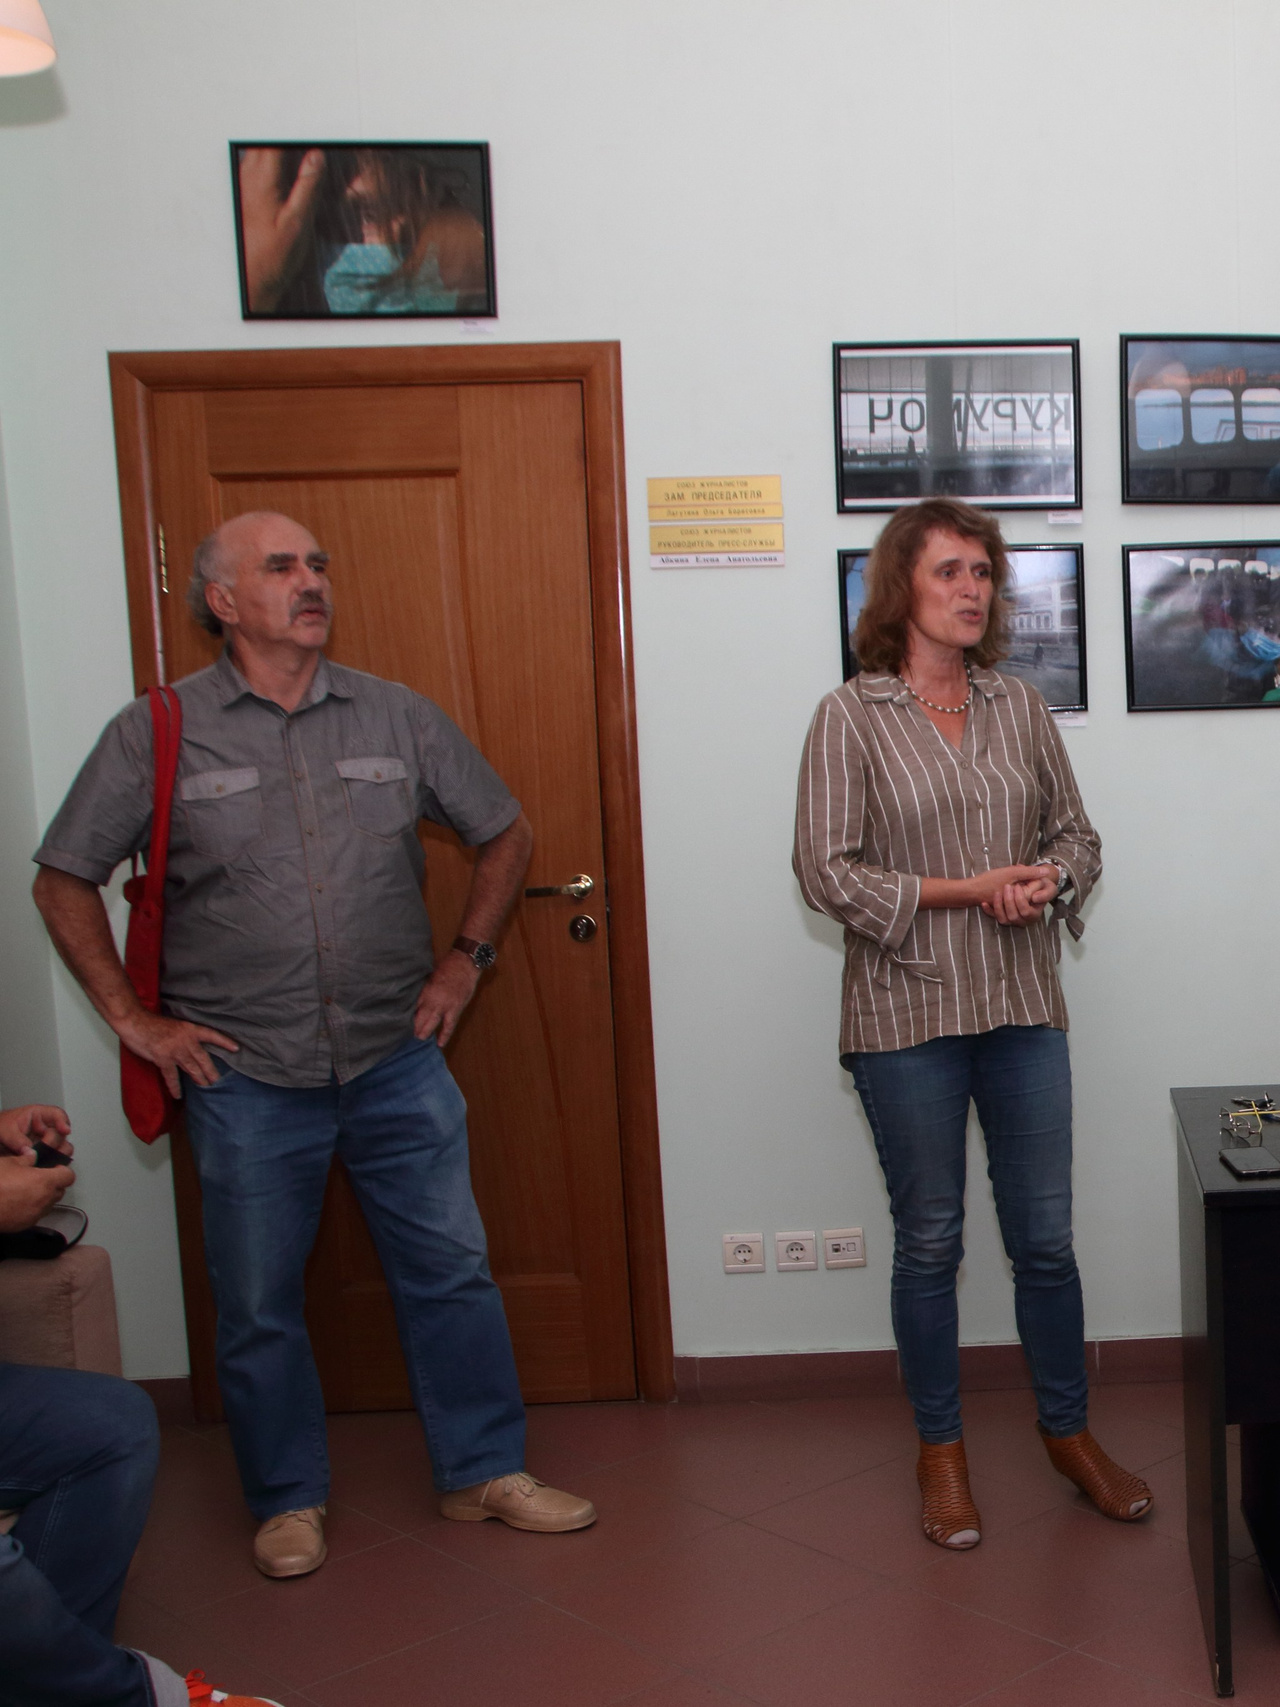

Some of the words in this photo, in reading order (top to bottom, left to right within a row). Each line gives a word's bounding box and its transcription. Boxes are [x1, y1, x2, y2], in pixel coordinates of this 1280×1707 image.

[676, 481, 696, 489] СОЮЗ
[700, 480, 749, 488] ЖУРНАЛИСТОВ
[664, 491, 686, 502] ЗАМ
[691, 489, 763, 501] ПРЕДСЕДАТЕЛЯ
[703, 507, 725, 516] Ольга
[728, 506, 766, 515] Борисовна
[679, 528, 700, 536] СОЮЗ
[703, 527, 752, 535] ЖУРНАЛИСТОВ
[657, 539, 715, 549] РУКОВОДИТЕЛЬ
[718, 538, 776, 548] ПРЕСС-СЛУЖБЫ
[695, 555, 720, 563] Елена
[727, 554, 778, 563] Анатольевна
